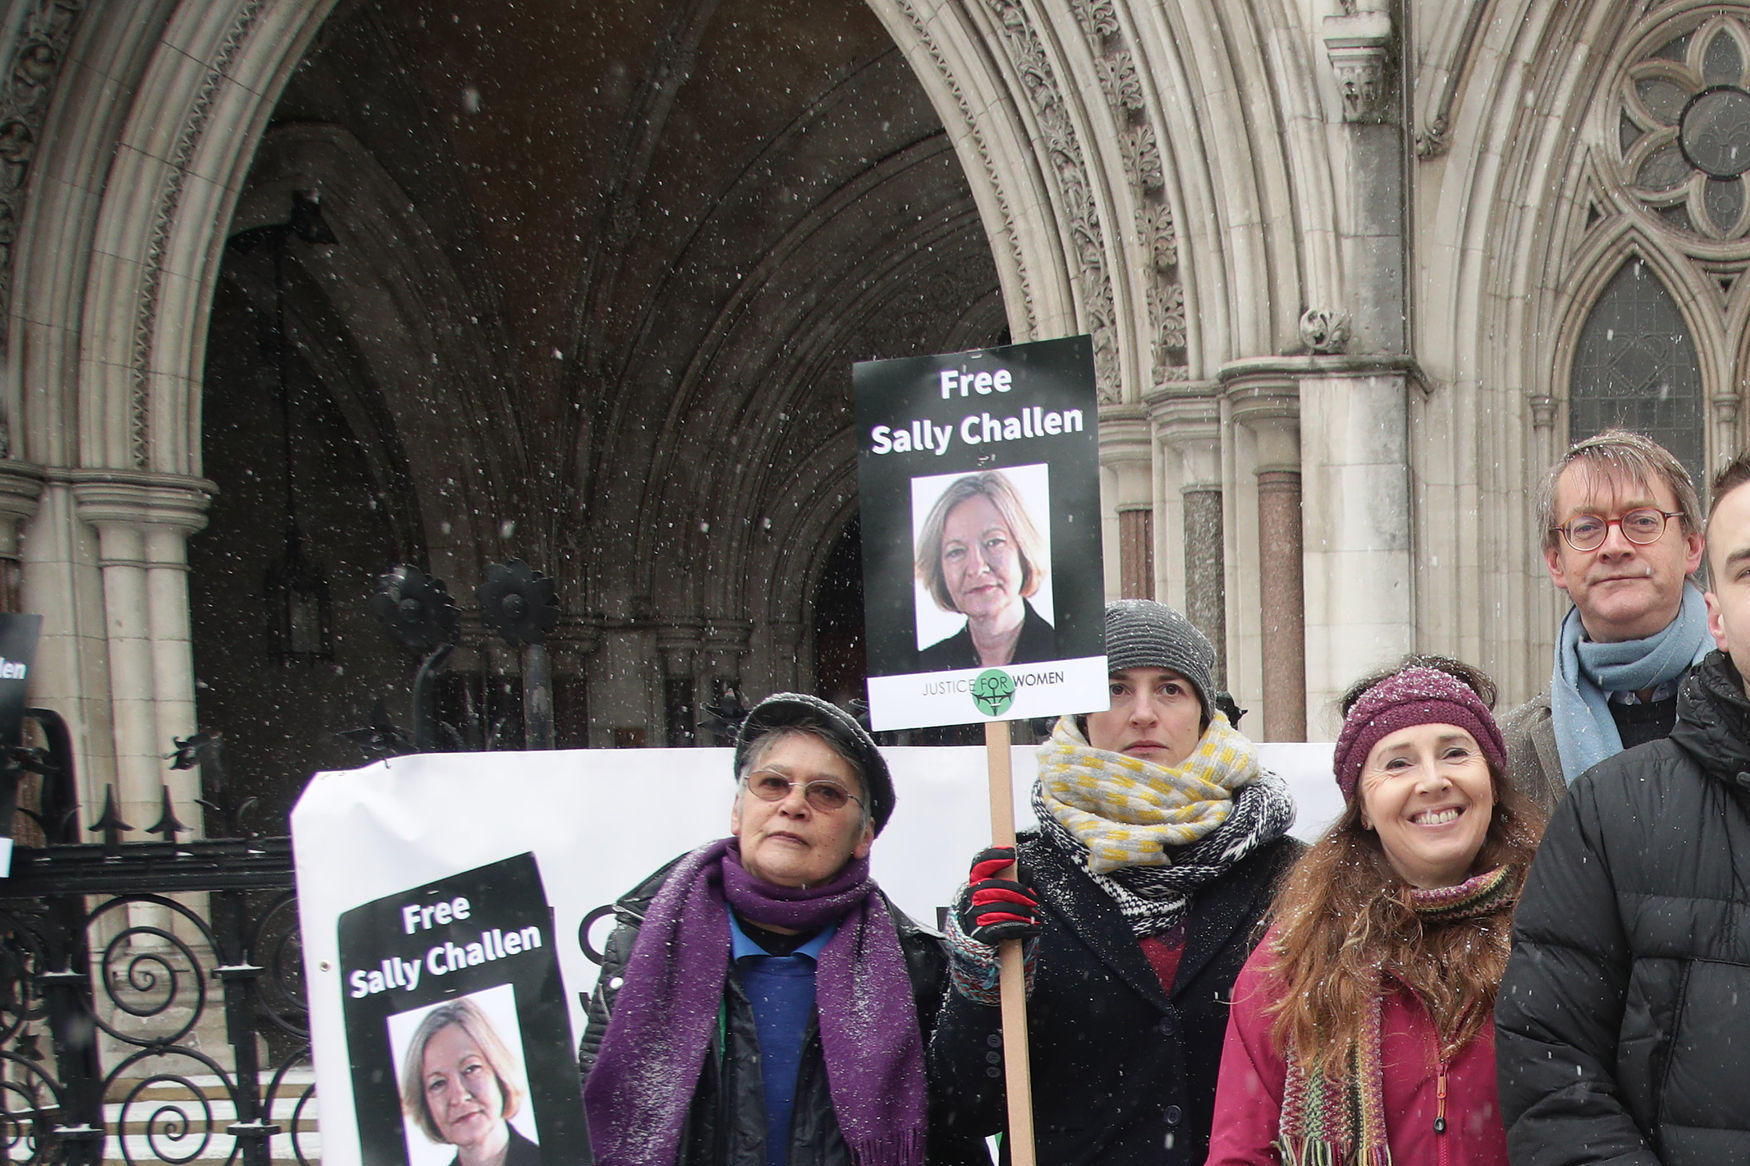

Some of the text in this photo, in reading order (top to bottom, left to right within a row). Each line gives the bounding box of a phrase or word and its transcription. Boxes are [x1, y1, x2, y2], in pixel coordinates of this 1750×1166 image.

[940, 368, 1013, 399] Free
[871, 406, 1084, 456] Sally Challen
[922, 671, 1064, 696] JUSTICE FOR WOMEN
[402, 897, 471, 935] Free
[350, 956, 422, 999] Sally
[426, 925, 543, 976] Challen
